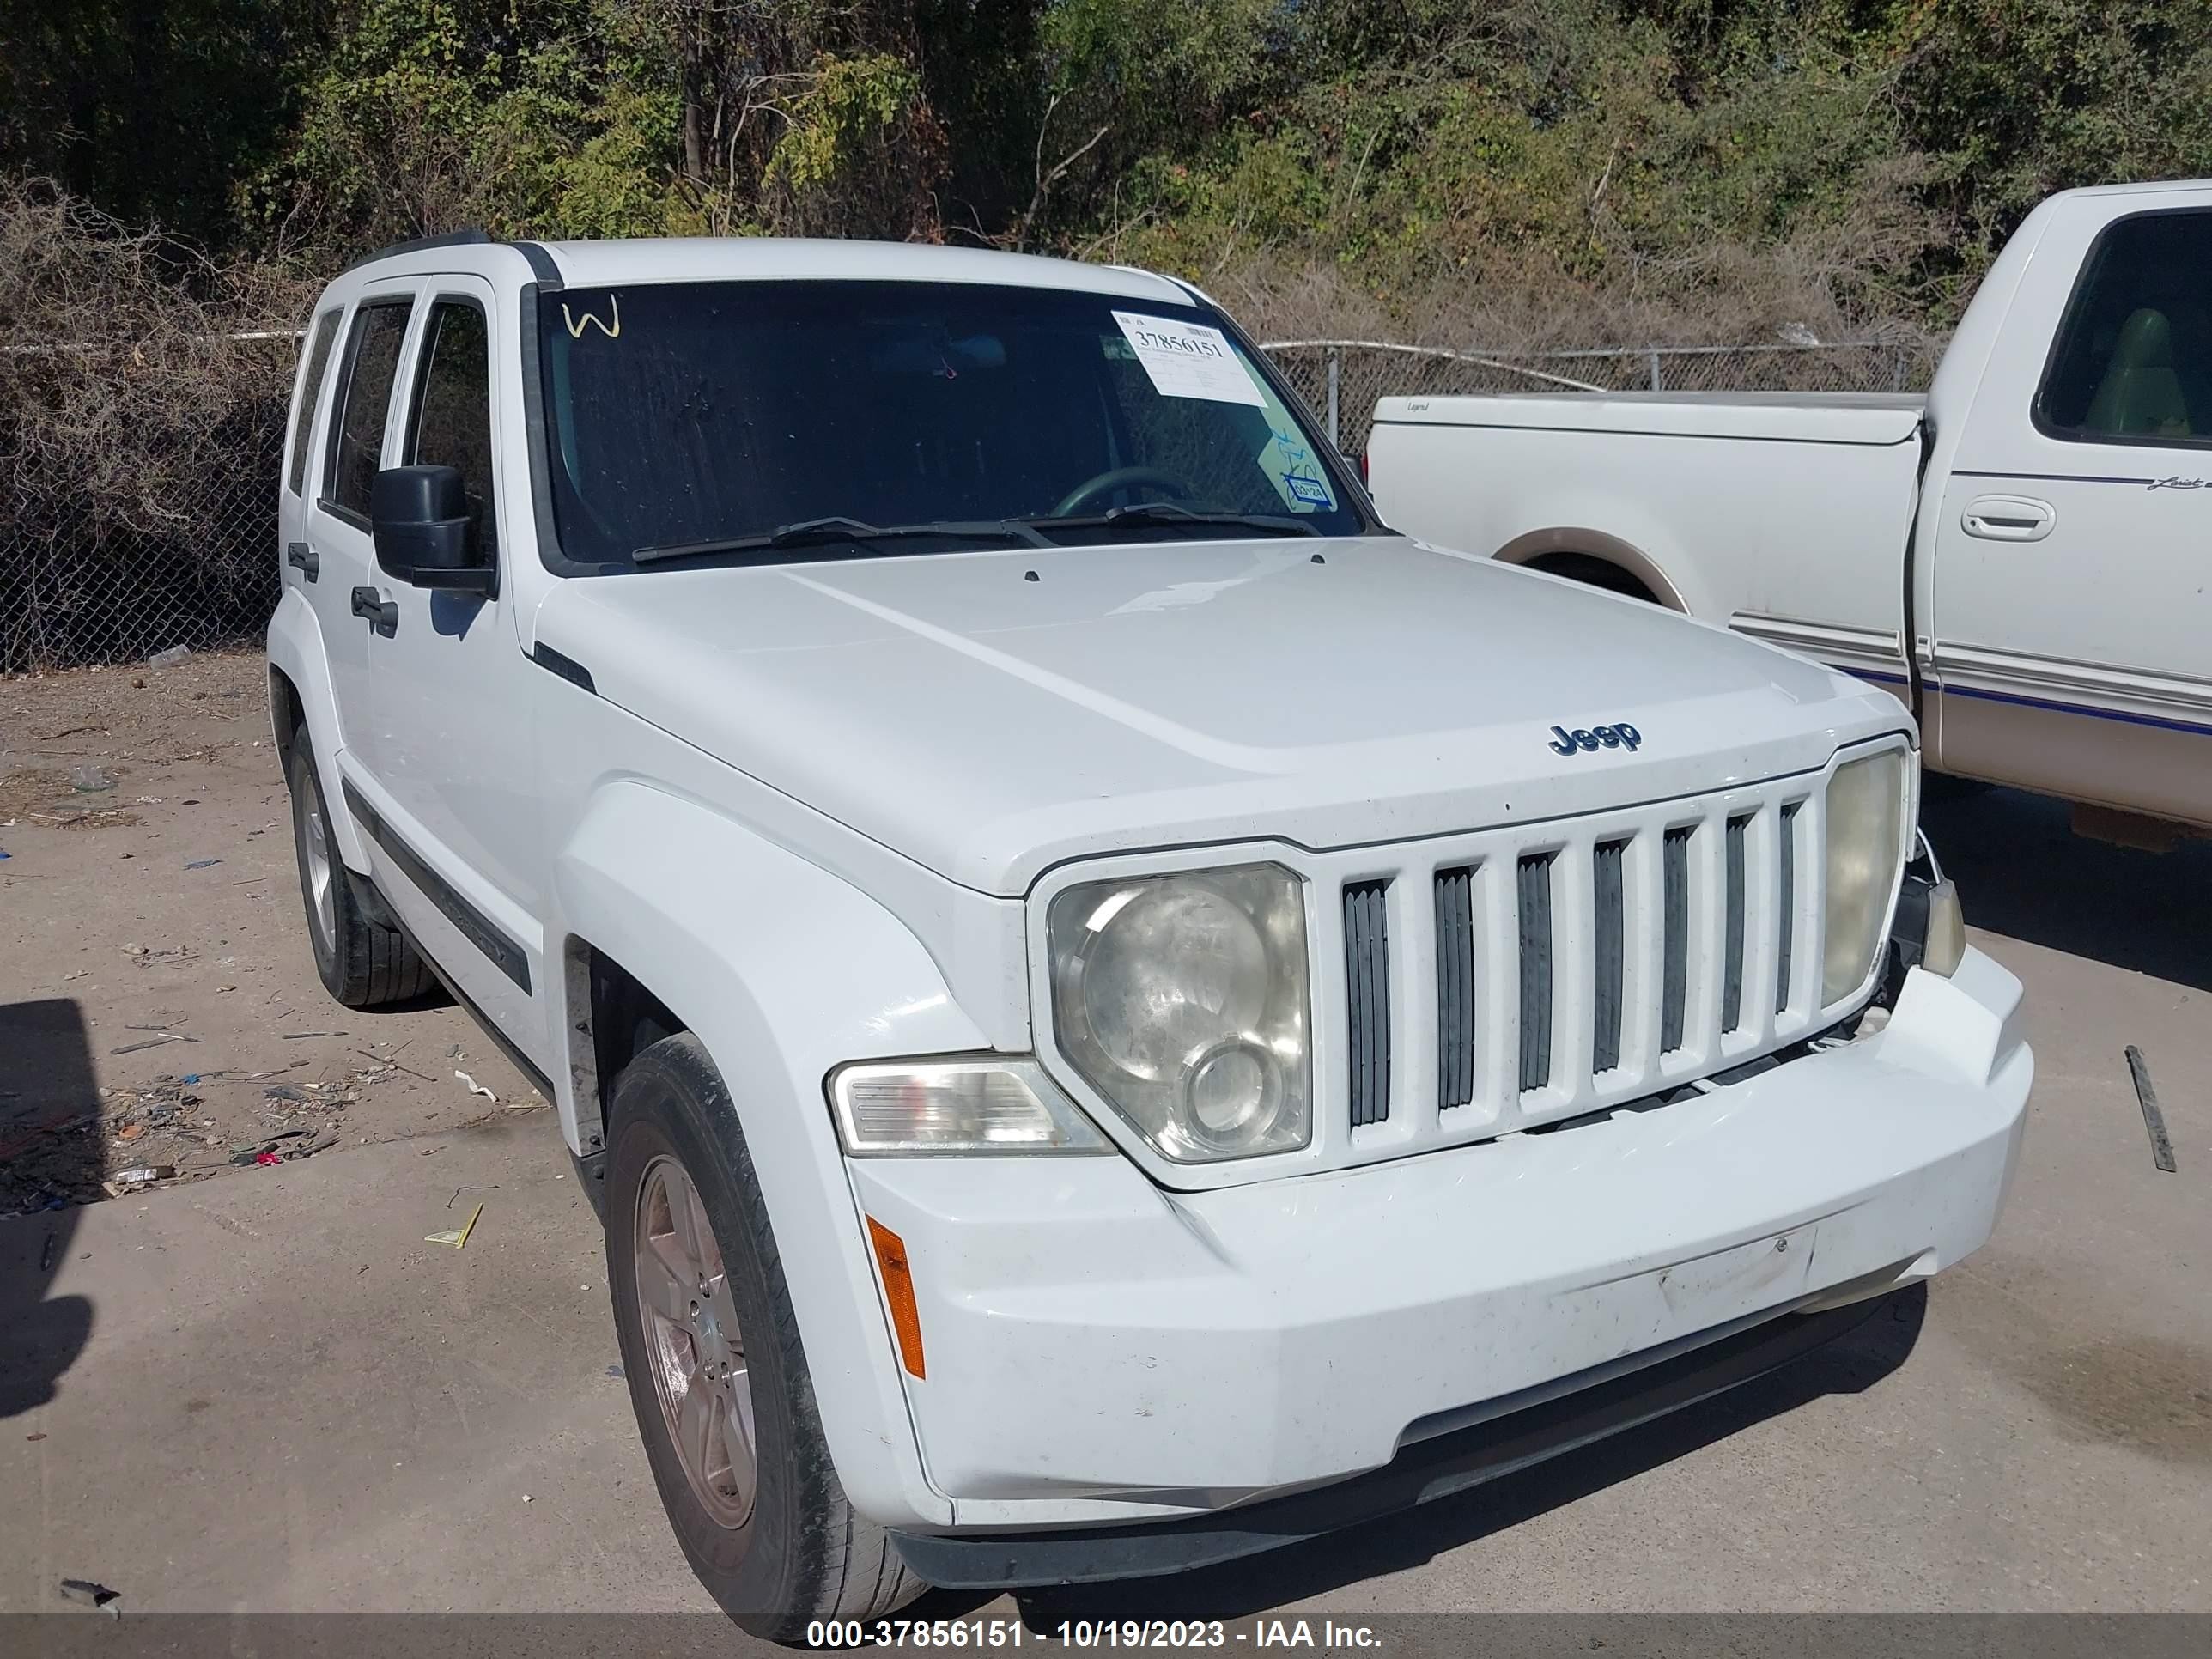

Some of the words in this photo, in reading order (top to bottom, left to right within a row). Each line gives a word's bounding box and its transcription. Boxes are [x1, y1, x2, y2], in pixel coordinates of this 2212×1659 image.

[561, 293, 620, 338] W
[1134, 331, 1224, 359] 37856151
[1547, 722, 1642, 757] Jeep
